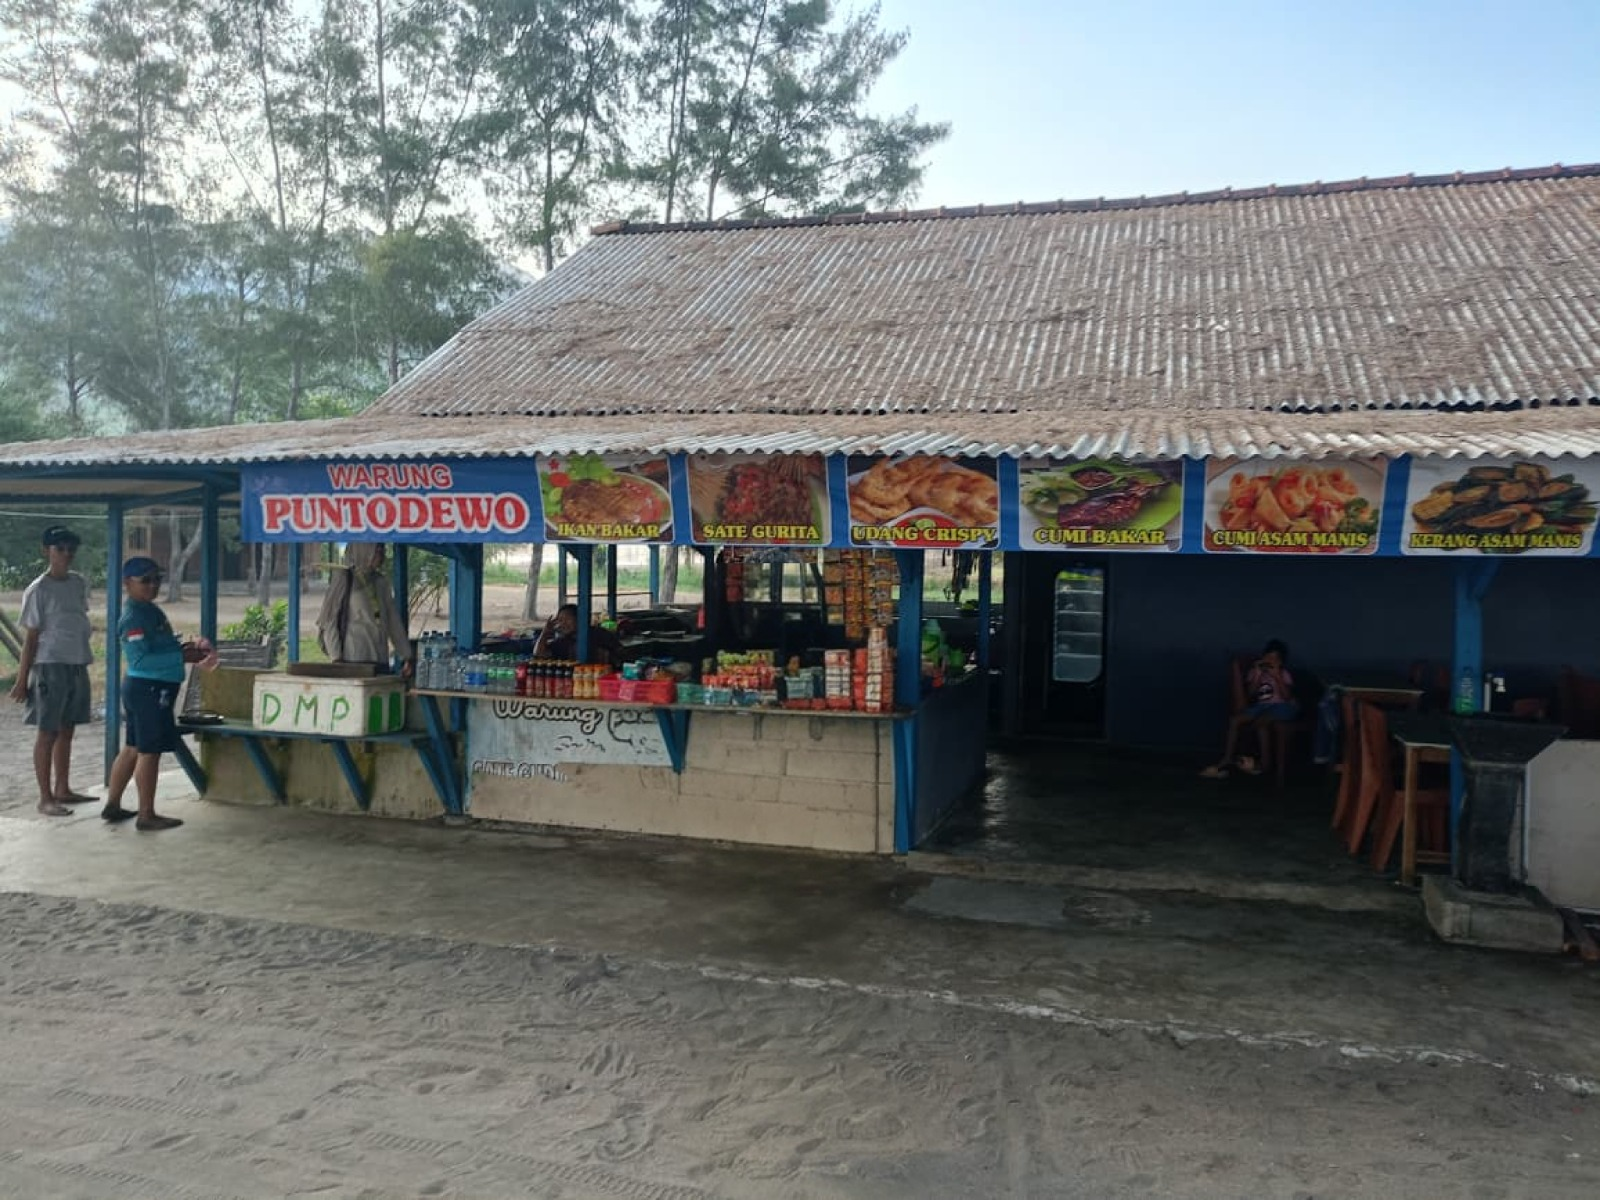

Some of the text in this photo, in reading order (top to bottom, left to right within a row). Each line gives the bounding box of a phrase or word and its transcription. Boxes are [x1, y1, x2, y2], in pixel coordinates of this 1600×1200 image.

[327, 463, 453, 490] WARUNG
[262, 493, 530, 534] PUNTODEWO
[557, 522, 662, 539] IKAN BAKAR
[703, 524, 821, 541] SATE GURITA
[852, 524, 998, 543] UDANG CRISPY
[1034, 527, 1167, 546] CUMI BAKAR
[1212, 530, 1370, 548] CUMI ASAM MANIS
[1410, 533, 1583, 549] KERANG ASAM MANIS
[492, 699, 603, 735] Warung
